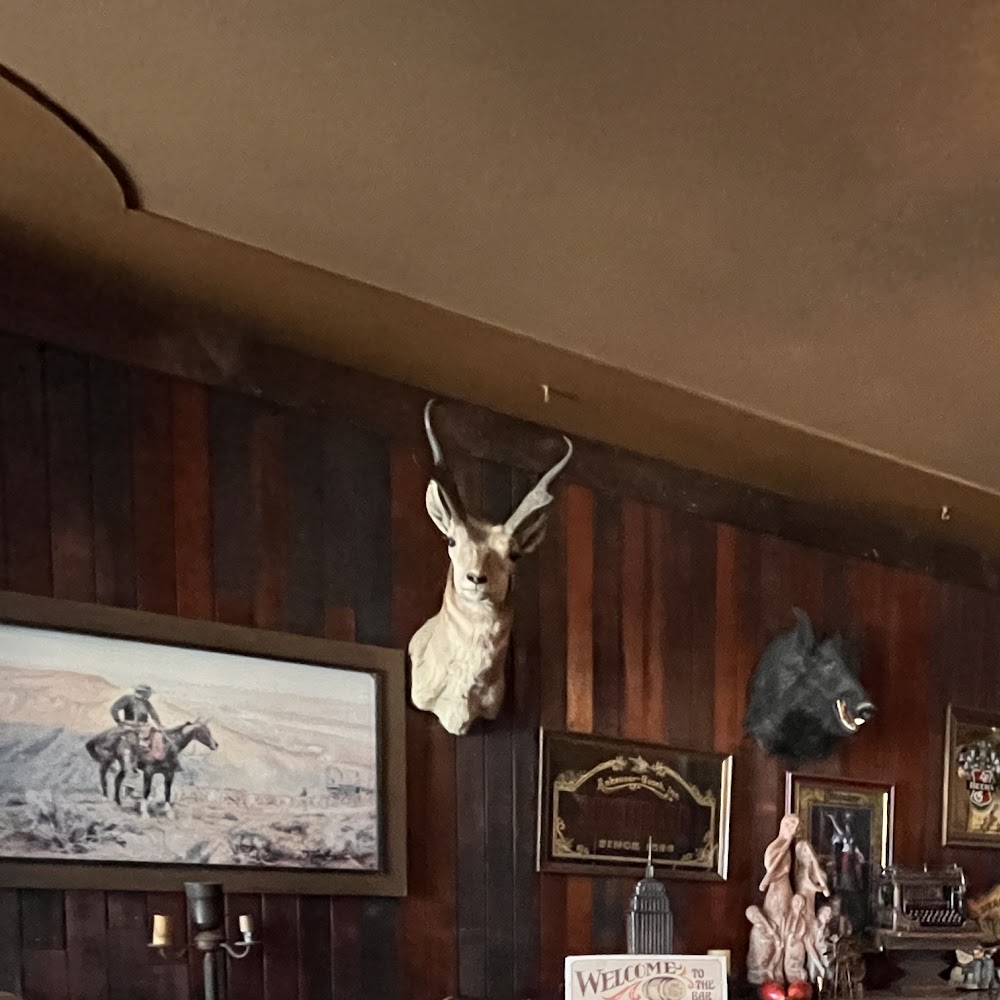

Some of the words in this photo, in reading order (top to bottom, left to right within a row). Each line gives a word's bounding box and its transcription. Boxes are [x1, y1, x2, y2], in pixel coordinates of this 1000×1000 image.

[598, 839, 641, 851] SINCE
[574, 961, 680, 997] WELCOME
[691, 968, 705, 979] TO
[695, 980, 715, 990] THE
